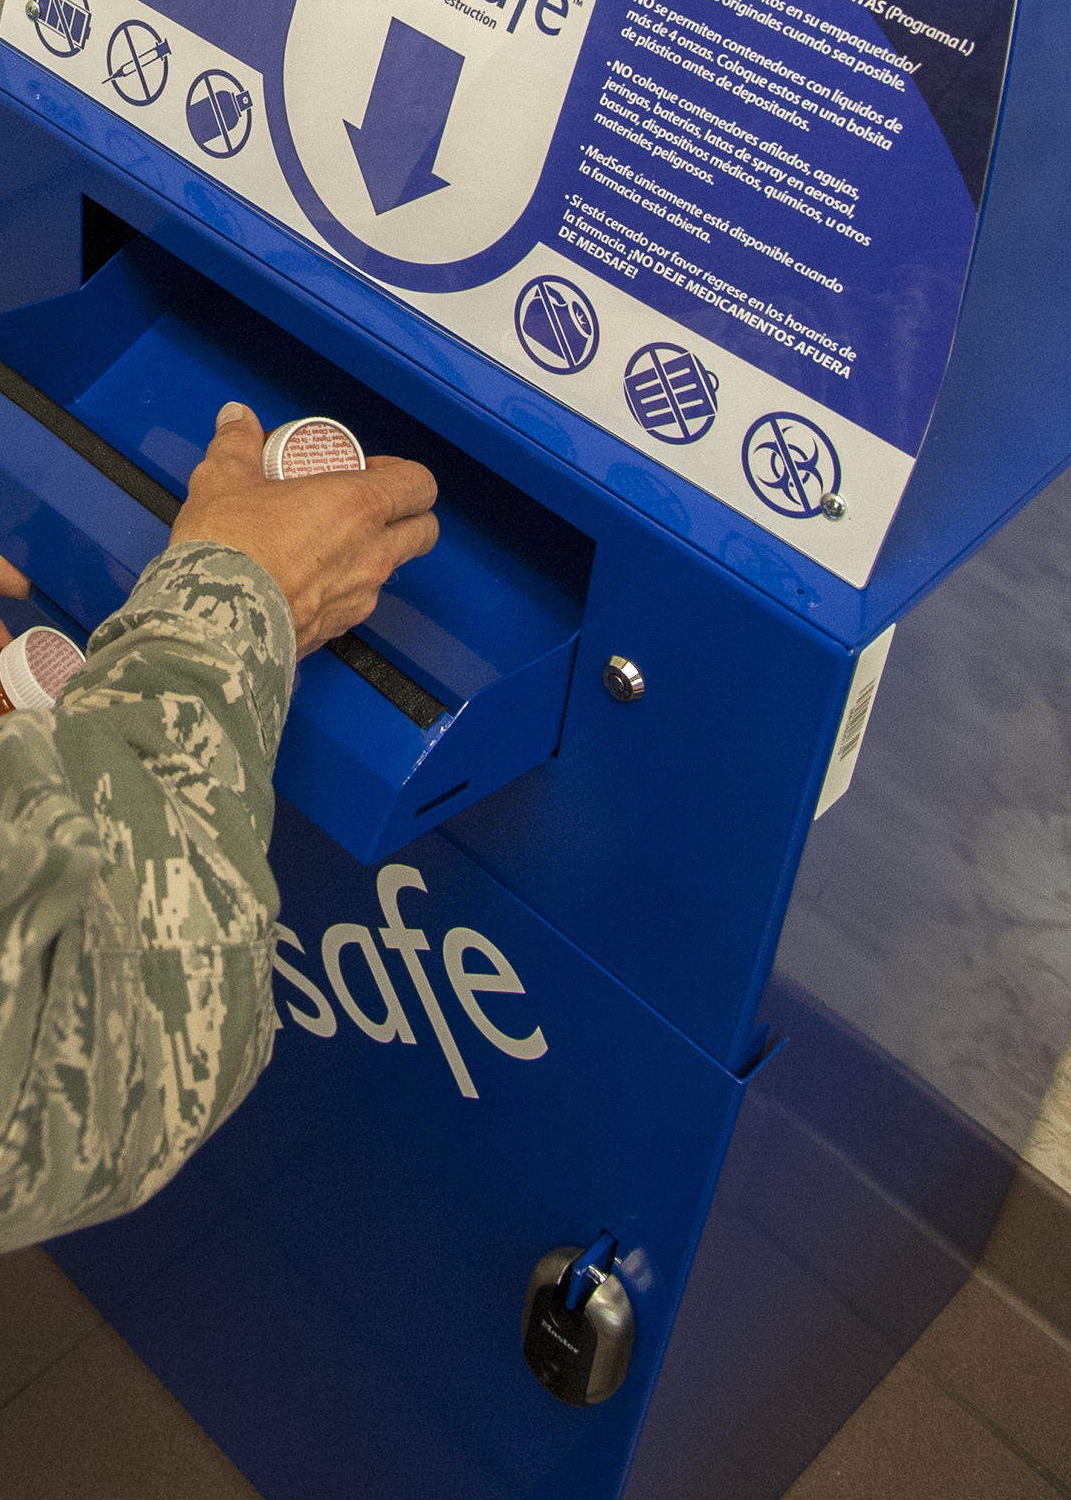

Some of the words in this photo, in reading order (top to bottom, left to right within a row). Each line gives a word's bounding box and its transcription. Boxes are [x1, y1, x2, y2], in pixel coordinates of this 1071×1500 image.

[653, 3, 669, 17] se
[666, 10, 722, 44] permiten
[722, 38, 807, 86] contenedores
[806, 80, 831, 99] con
[830, 88, 885, 125] líquidos
[884, 117, 903, 134] de
[782, 25, 832, 55] cuando
[831, 49, 856, 67] sea
[853, 60, 906, 92] posible.
[785, 5, 804, 20] en
[802, 13, 820, 28] su
[819, 21, 922, 74] empaquetado/
[885, 5, 960, 49] (Programa
[958, 38, 975, 57] I.)
[593, 113, 654, 151] materiales
[651, 145, 714, 186] peligrosos.
[599, 92, 640, 126] basura,
[641, 118, 710, 161] dispositivos
[709, 155, 762, 192] médicos,
[764, 185, 823, 224] químicos,
[825, 216, 837, 228] u
[836, 223, 872, 246] otros
[611, 60, 632, 79] NO
[632, 74, 679, 104] coloque
[678, 98, 760, 146] contenedores
[758, 141, 811, 176] afilados,
[813, 169, 860, 201] agujas,
[558, 225, 578, 244] DE
[575, 236, 639, 279] MEDSAFE!
[585, 144, 635, 180] MedSafe
[634, 173, 703, 218] únicamente
[702, 213, 730, 233] está
[729, 226, 794, 267] disponible
[794, 262, 844, 293] cuando
[563, 208, 576, 224] la
[575, 216, 627, 255] farmacia.
[626, 249, 654, 268] ¡NO
[653, 261, 687, 287] DEJE
[684, 279, 796, 347] MEDICAMENTOS
[793, 341, 851, 379] AFUERA
[273, 863, 549, 1099] safe
